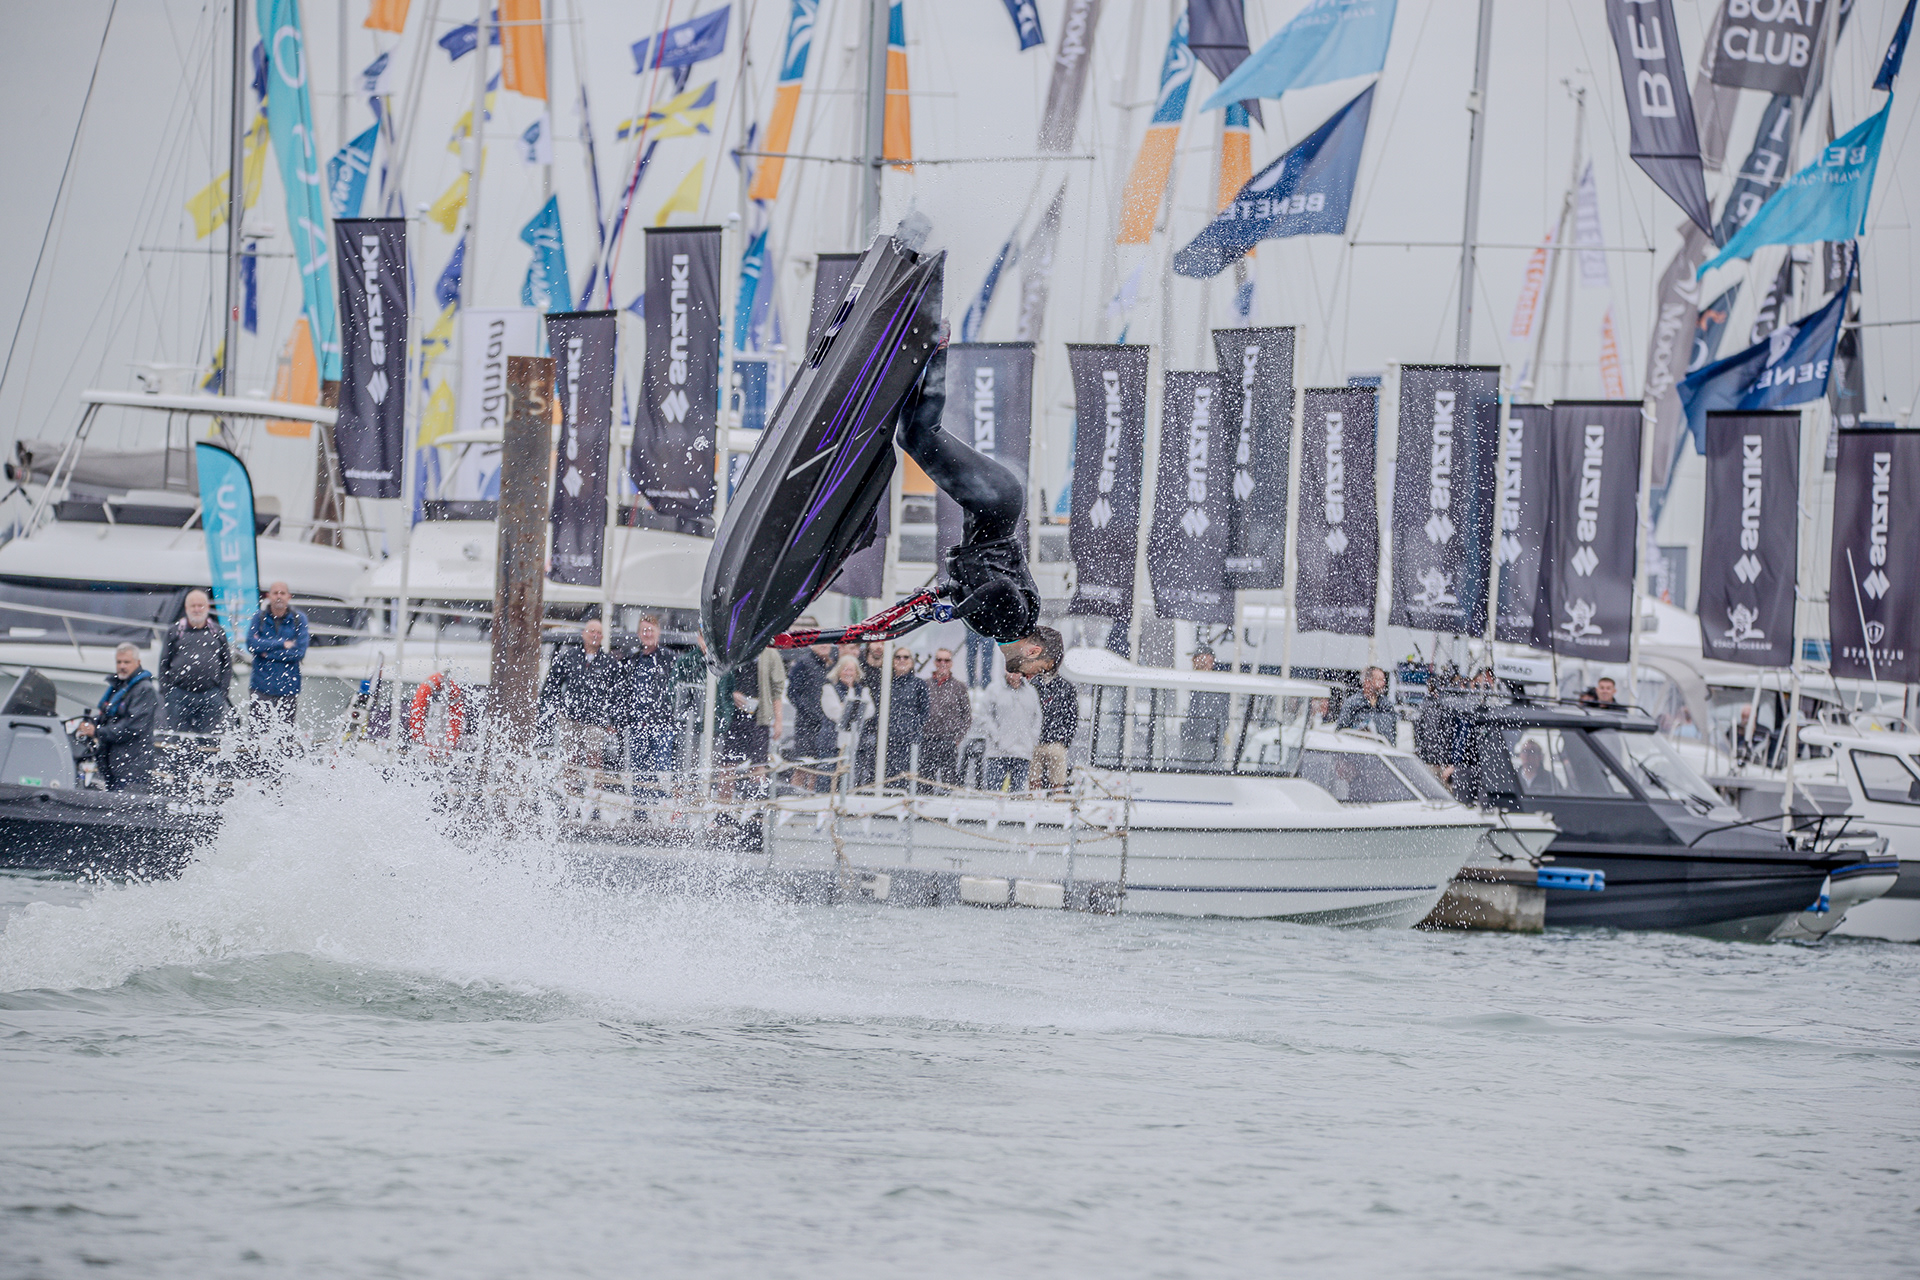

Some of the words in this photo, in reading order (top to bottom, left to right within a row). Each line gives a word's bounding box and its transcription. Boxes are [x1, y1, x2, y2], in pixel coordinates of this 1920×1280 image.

[1625, 0, 1677, 117] BE
[1722, 26, 1811, 67] CLUB
[1645, 303, 1686, 399] Moody
